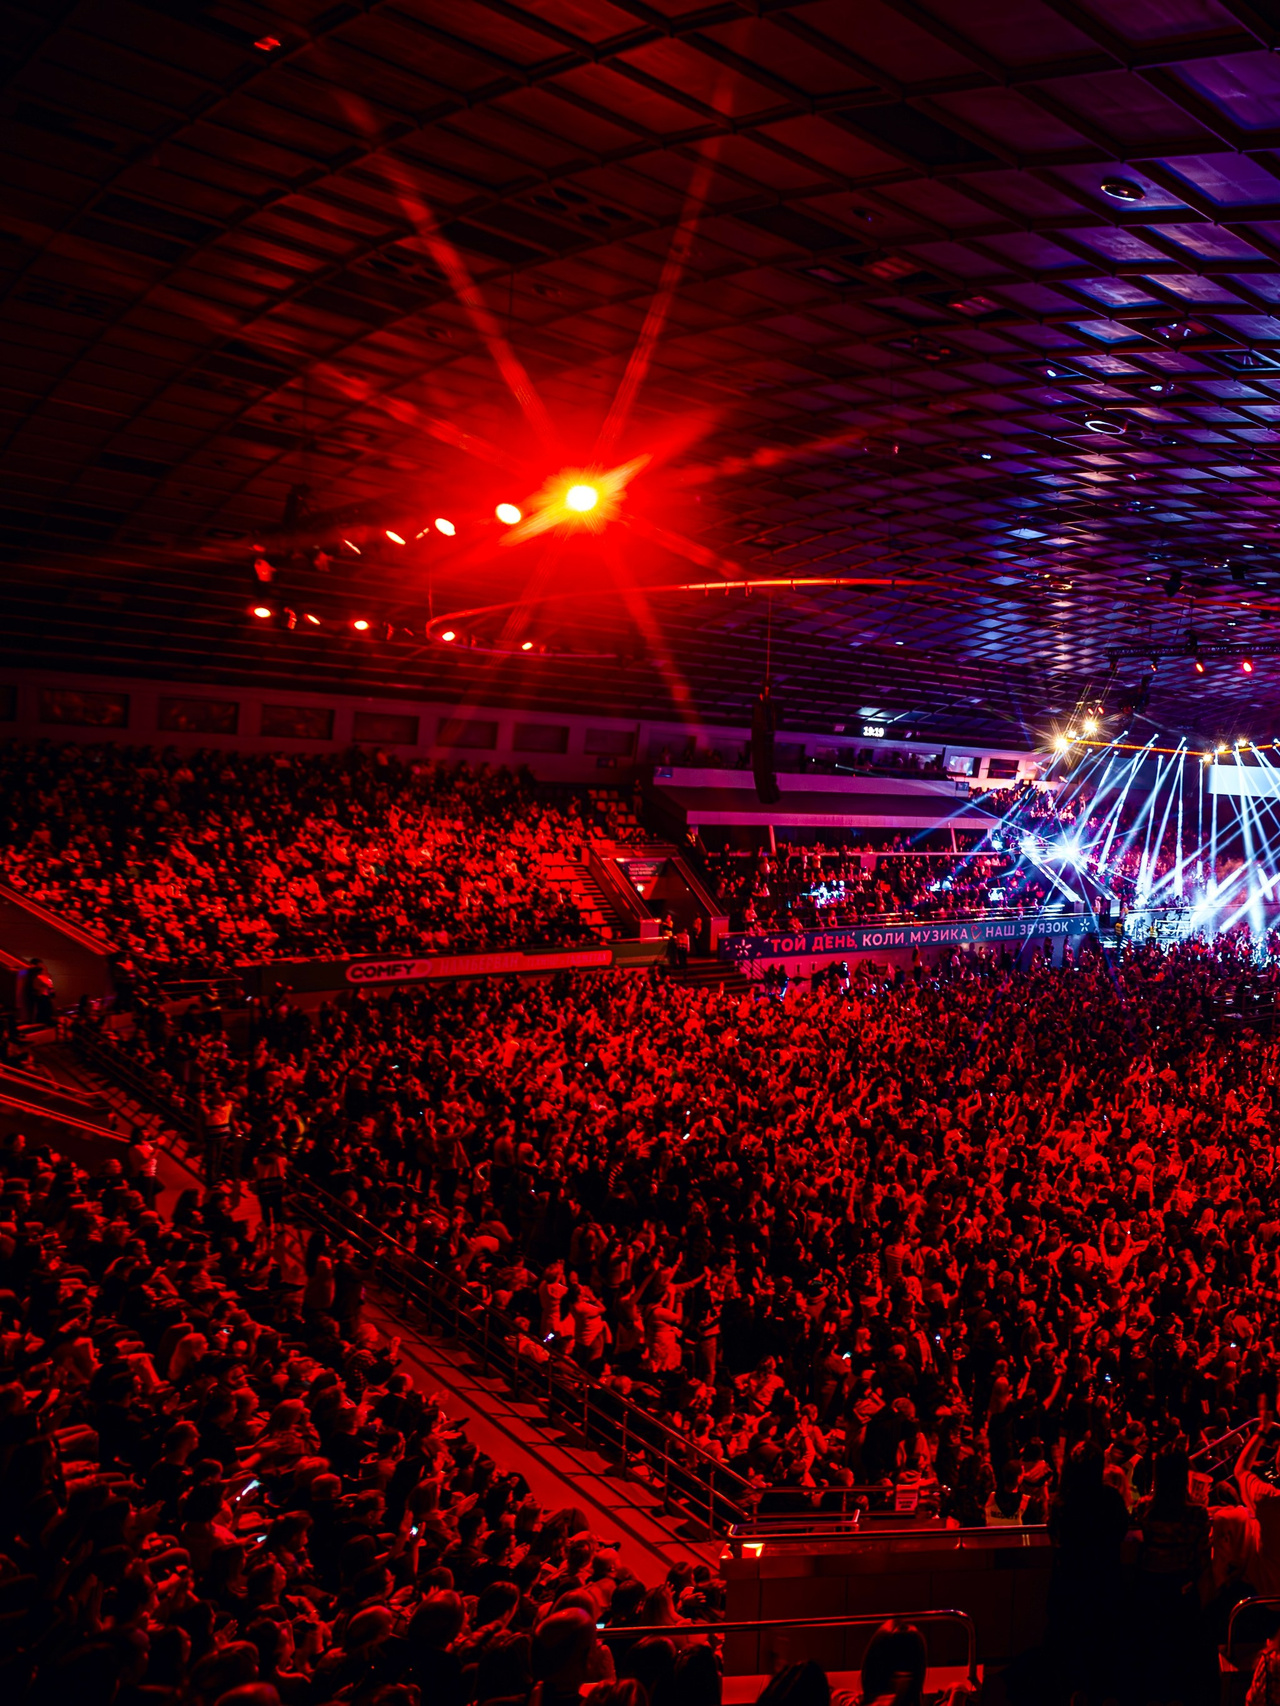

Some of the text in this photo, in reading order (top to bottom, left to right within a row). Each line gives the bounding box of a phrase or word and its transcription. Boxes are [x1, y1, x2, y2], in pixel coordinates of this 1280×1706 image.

[770, 921, 1069, 953] ТОЙ ДЕНЬ, КОЛИ МУЗИКА НАШ ЗВ'ЯЗОК
[350, 963, 416, 979] COMFY
